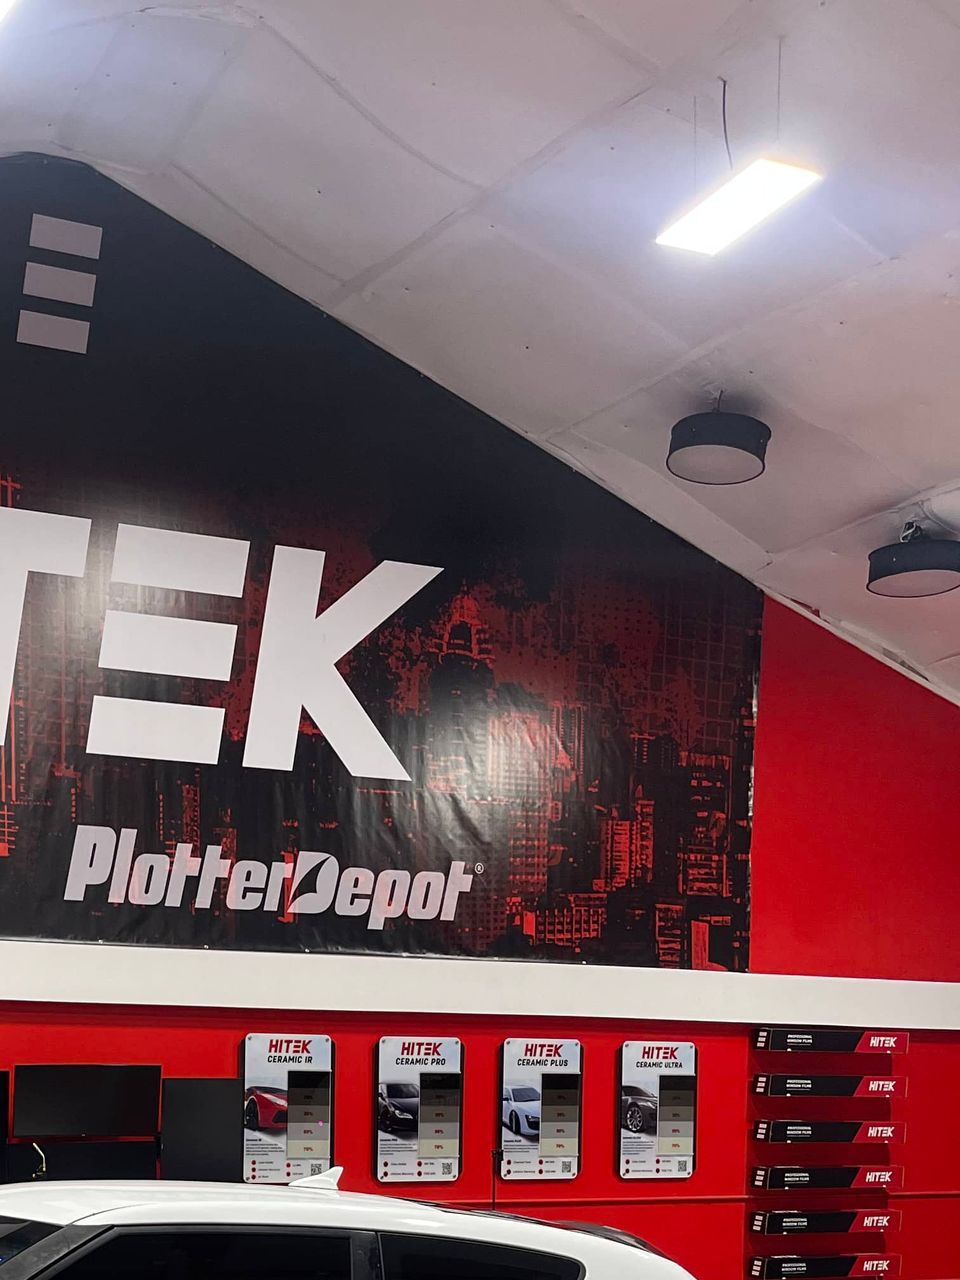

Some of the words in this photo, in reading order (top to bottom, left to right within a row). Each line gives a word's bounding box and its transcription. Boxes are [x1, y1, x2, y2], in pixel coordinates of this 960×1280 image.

[268, 1039, 313, 1054] HITEK
[869, 1036, 897, 1048] HITEK
[401, 1042, 443, 1056] HITEK
[524, 1043, 564, 1058] HITEK
[642, 1046, 679, 1060] HITEK
[267, 1055, 303, 1064] CERAMIC
[304, 1056, 313, 1064] IR
[395, 1057, 429, 1066] CERAMIC
[431, 1058, 446, 1066] PRO
[517, 1058, 548, 1066] CERAMIC
[550, 1059, 569, 1067] PLUS
[664, 1061, 683, 1069] ULTRA
[868, 1081, 896, 1092] HITEK
[867, 1126, 895, 1137] HITEK
[865, 1171, 893, 1183] HITEK
[863, 1216, 890, 1227] HITEK
[863, 1260, 890, 1271] HITEK
